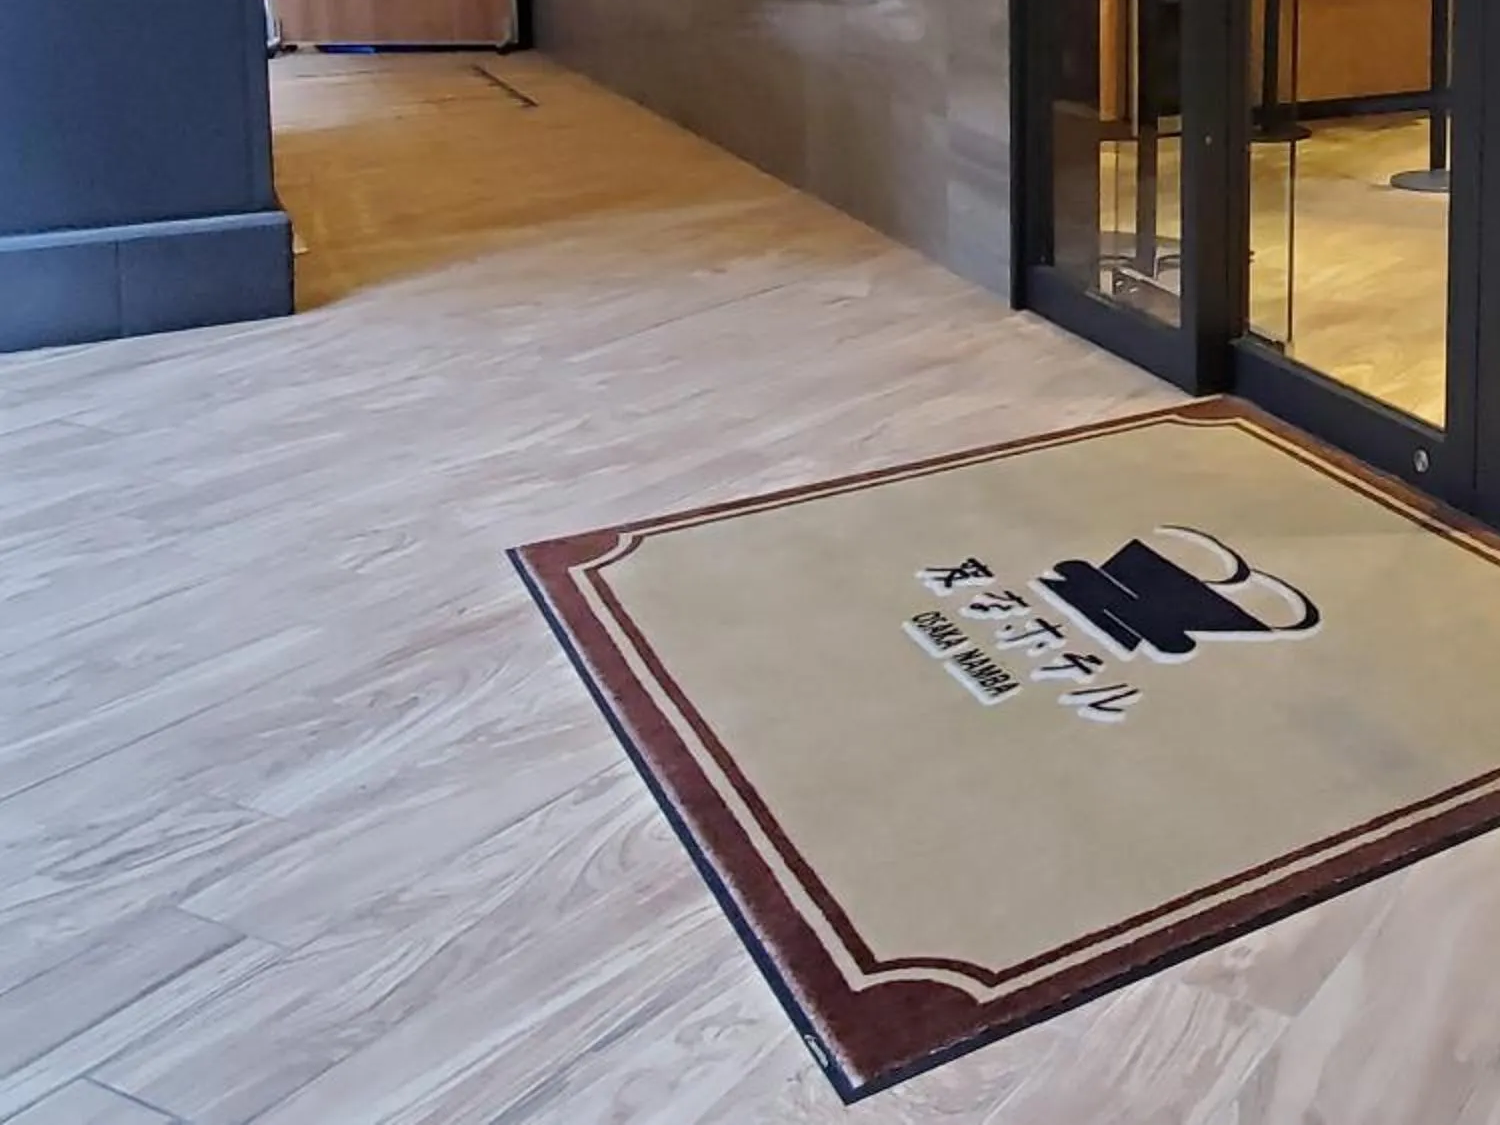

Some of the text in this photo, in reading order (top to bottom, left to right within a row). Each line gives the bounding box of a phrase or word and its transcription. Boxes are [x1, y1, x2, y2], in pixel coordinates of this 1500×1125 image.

[911, 611, 1020, 698] OSAKA NAMBA
[922, 556, 1141, 713] 変なホテル
